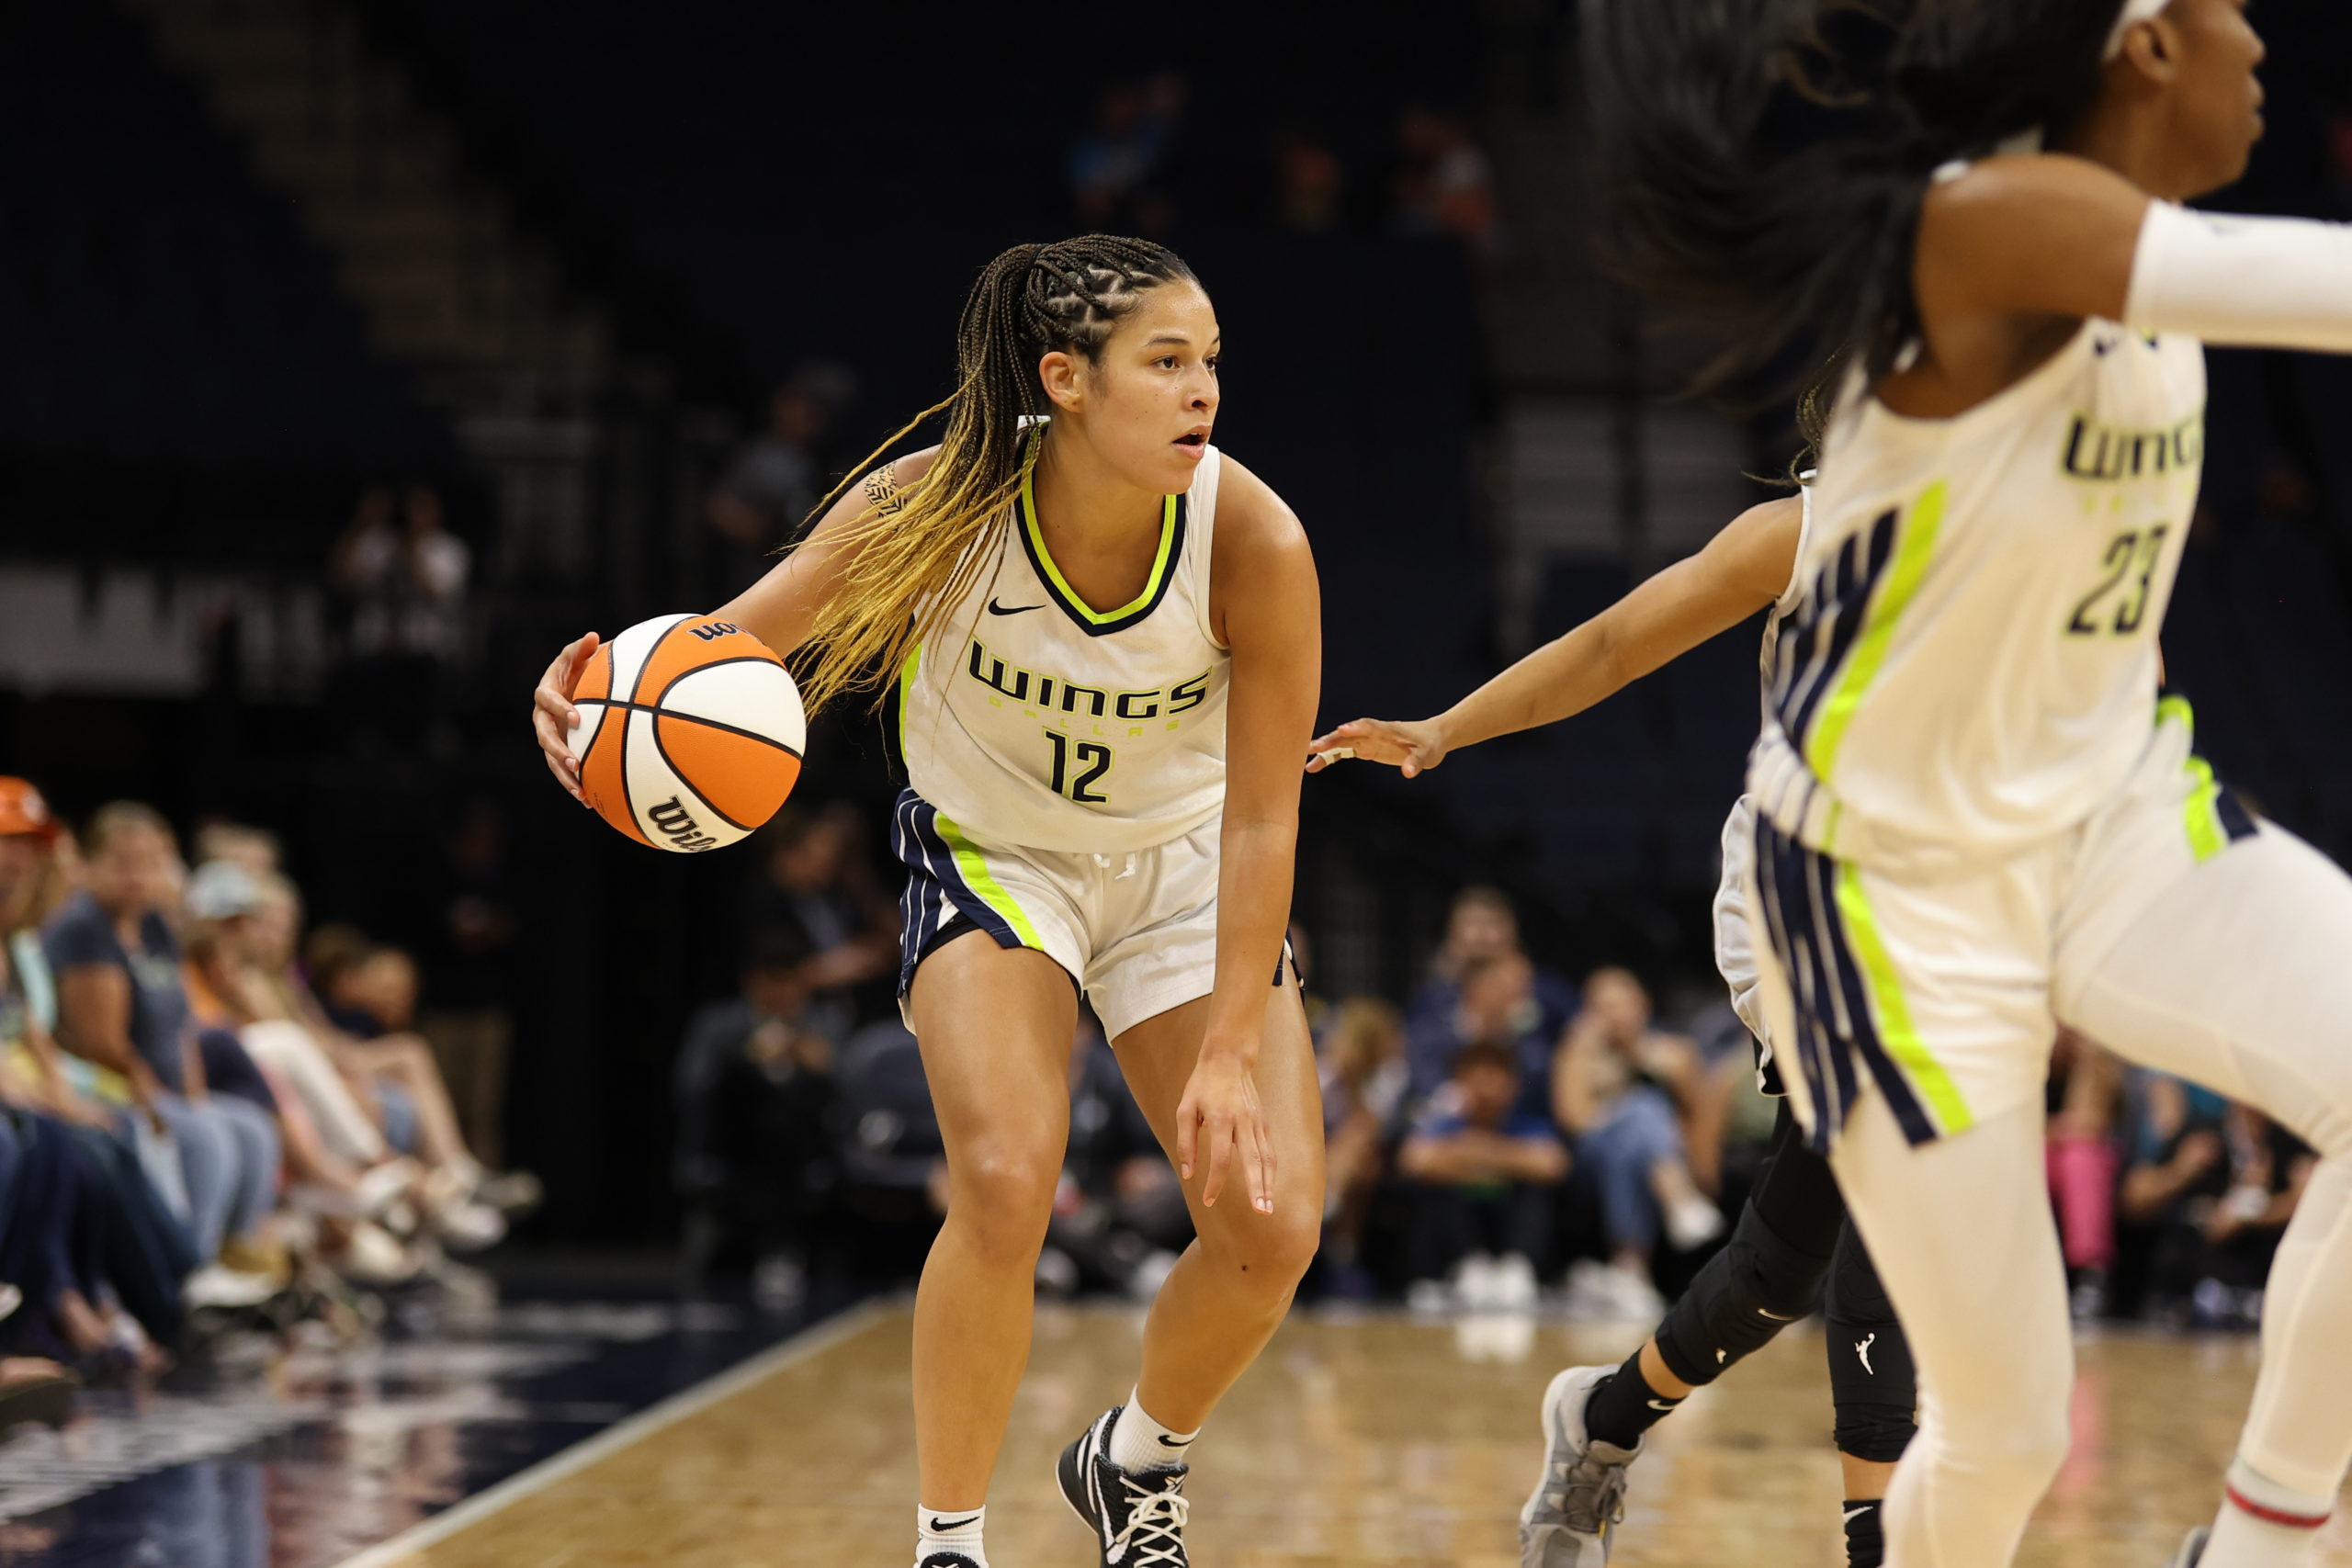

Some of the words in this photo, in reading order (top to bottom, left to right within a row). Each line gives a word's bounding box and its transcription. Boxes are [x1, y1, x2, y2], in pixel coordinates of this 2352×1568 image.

[2064, 522, 2170, 636] 23
[967, 634, 1213, 721] WINGS
[1043, 726, 1115, 805] 12
